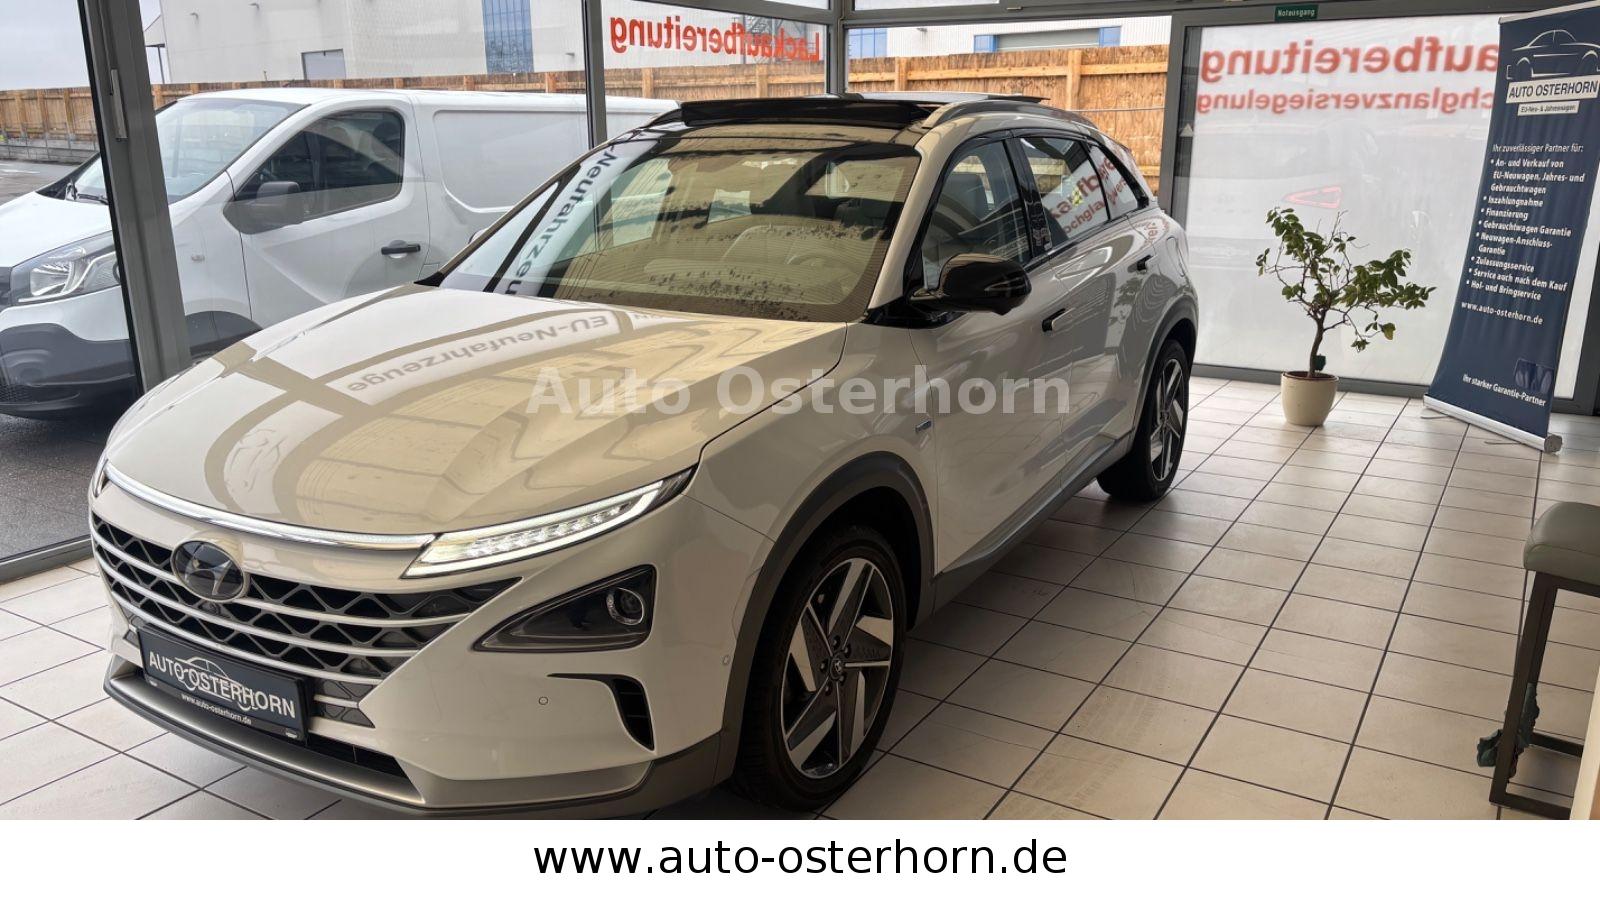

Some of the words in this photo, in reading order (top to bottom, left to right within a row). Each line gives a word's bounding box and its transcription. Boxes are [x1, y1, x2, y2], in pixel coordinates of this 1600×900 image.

[1277, 9, 1316, 17] Notausgang
[1509, 86, 1533, 98] AUTO
[1536, 80, 1598, 96] OSTERHORN
[1502, 144, 1543, 154] zuverlässiger
[1545, 144, 1569, 152] Partner
[1571, 143, 1584, 153] für:
[1495, 159, 1506, 167] An-
[1507, 159, 1520, 167] und
[1522, 159, 1549, 168] Verkauf
[1551, 160, 1564, 168] von
[1493, 171, 1540, 182] EU-Neuwagen,
[1541, 172, 1568, 182] Jahres-
[1569, 173, 1585, 182] und
[1490, 183, 1546, 195] Gebrauchtwagen
[1488, 196, 1543, 207] Inzahlungnahme
[1486, 208, 1528, 221] Finanzierung
[1483, 220, 1538, 234] Gebrauchtwagen
[1539, 225, 1572, 237] Garantie
[1480, 232, 1553, 248] Neuwagen-Anschluss-
[1478, 244, 1506, 255] Garantie
[1476, 256, 1535, 273] Zulassungsservice
[1473, 268, 1496, 279] Service
[1497, 273, 1513, 282] auch
[1514, 275, 1531, 284] nach
[1532, 278, 1547, 288] dem
[1549, 280, 1568, 291] Kauf
[1471, 280, 1484, 289] Hol-
[1485, 284, 1498, 292] und
[1499, 285, 1542, 300] Bringservice
[1461, 302, 1544, 324] www.auto-osterhorn.de
[350, 315, 609, 392] EU-Neufahrzeuge
[1462, 373, 1471, 384] Ihr
[1471, 378, 1493, 389] starker
[1492, 383, 1547, 406] Garantie-Partner
[149, 652, 185, 681] AUTO
[188, 668, 296, 719] OSTERHORN
[181, 693, 252, 725] www.auto-osterhorn.de
